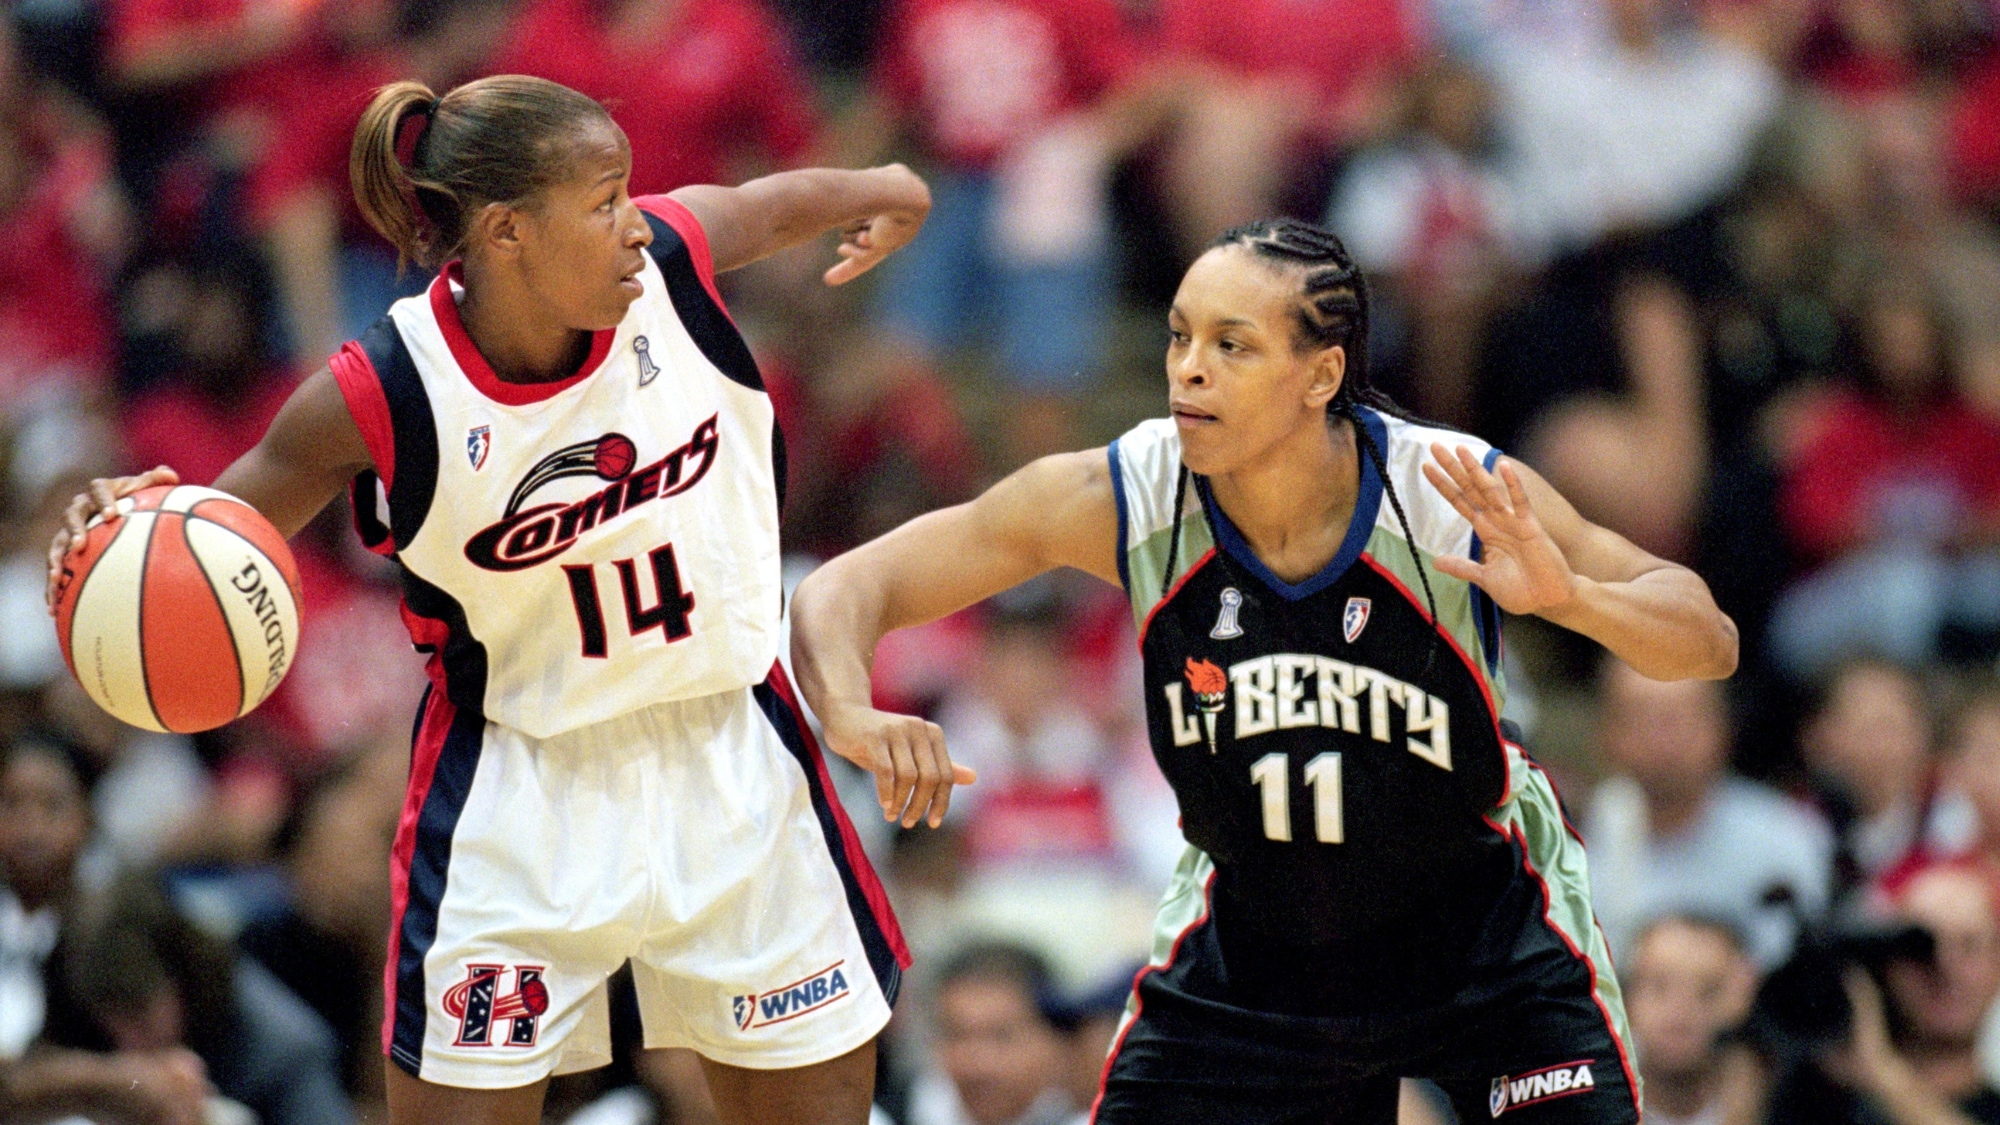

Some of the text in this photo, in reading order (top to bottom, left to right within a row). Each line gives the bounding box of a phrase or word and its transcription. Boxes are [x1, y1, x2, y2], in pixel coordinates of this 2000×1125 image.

[464, 411, 719, 572] COMETS
[231, 562, 285, 700] PALDING
[560, 541, 695, 659] 14
[1250, 752, 1344, 844] 11
[760, 968, 849, 1019] WNBA
[1510, 1065, 1594, 1103] WNBA
